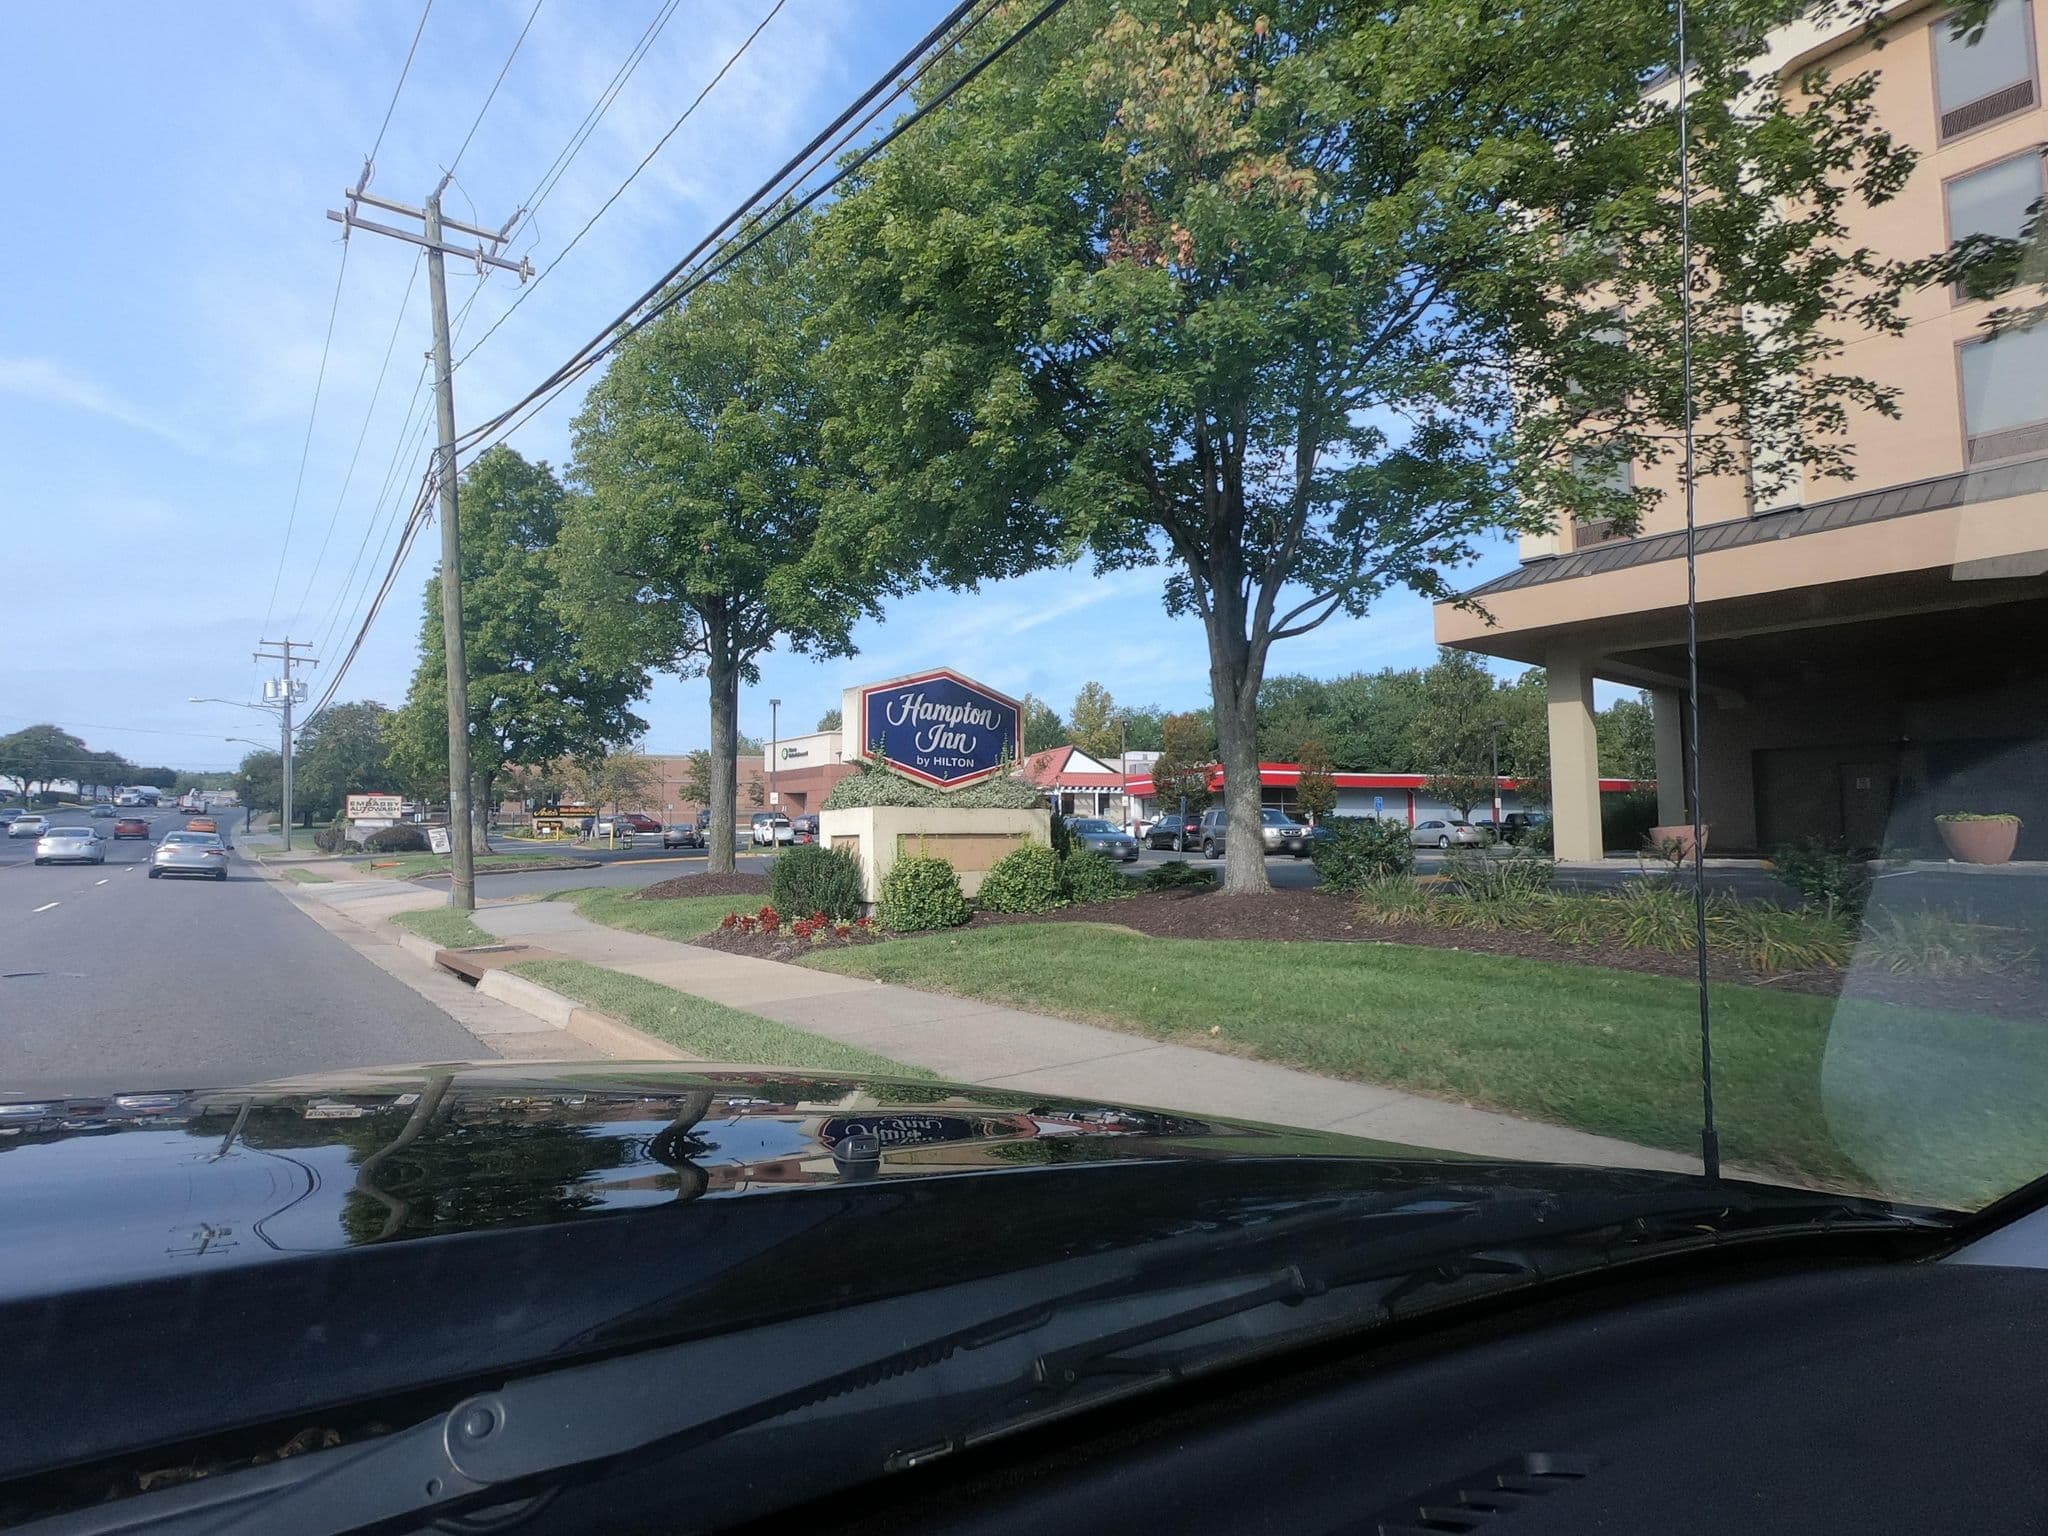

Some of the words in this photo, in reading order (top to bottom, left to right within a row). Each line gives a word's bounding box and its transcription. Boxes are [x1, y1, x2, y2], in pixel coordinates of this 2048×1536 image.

[886, 693, 1001, 731] Hampton
[915, 724, 976, 754] Inn
[916, 755, 930, 767] by
[933, 756, 975, 768] HILTON
